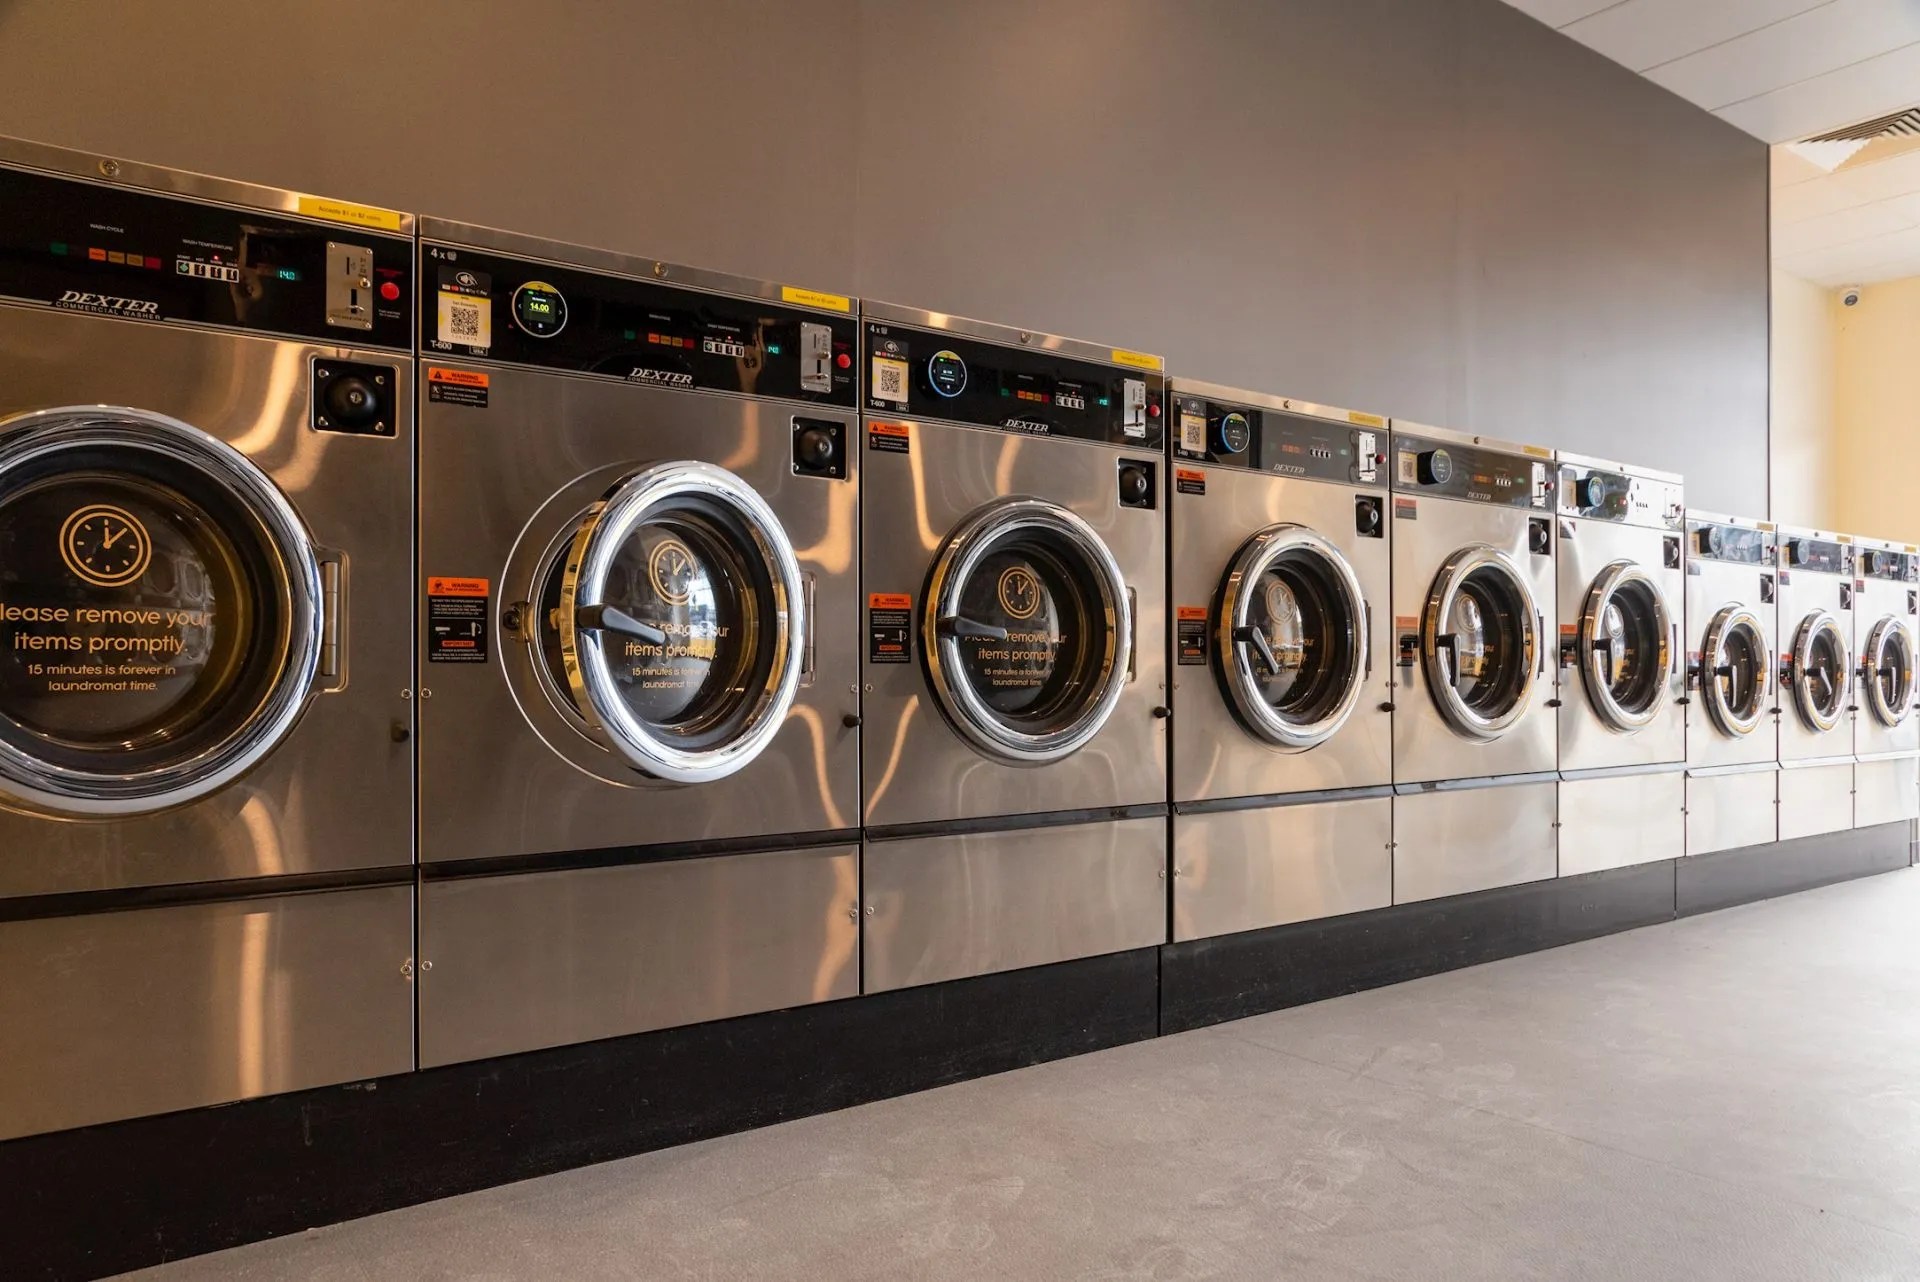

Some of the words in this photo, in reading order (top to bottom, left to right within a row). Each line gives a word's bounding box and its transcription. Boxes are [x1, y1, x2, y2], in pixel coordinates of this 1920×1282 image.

[59, 290, 159, 314] DEXTER
[530, 302, 550, 312] 14.00
[55, 301, 119, 316] COMMERCIAL
[122, 309, 161, 320] WASHER
[430, 339, 453, 350] T-600
[630, 367, 694, 384] DEXTER
[1005, 418, 1049, 432] DEXTER
[1273, 463, 1306, 474] DEXTER
[0, 602, 70, 622] lease
[75, 608, 161, 625] remove
[166, 611, 213, 629] your
[1006, 632, 1045, 643] remove
[14, 632, 83, 650] items
[88, 635, 188, 655] promptly.
[625, 641, 663, 657] items
[978, 647, 1010, 660] items
[1011, 649, 1057, 662] promptly.
[28, 664, 43, 675] 15
[46, 664, 102, 675] minutes
[105, 664, 115, 675] is
[119, 664, 162, 675] forever
[164, 664, 176, 675] in
[632, 667, 641, 676] 15
[642, 667, 673, 676] minutes
[984, 668, 992, 676] 15
[992, 668, 1018, 676] minutes
[48, 681, 127, 691] laundromat
[129, 681, 158, 691] time.
[642, 680, 685, 689] laundromat
[992, 678, 1029, 687] laundromat
